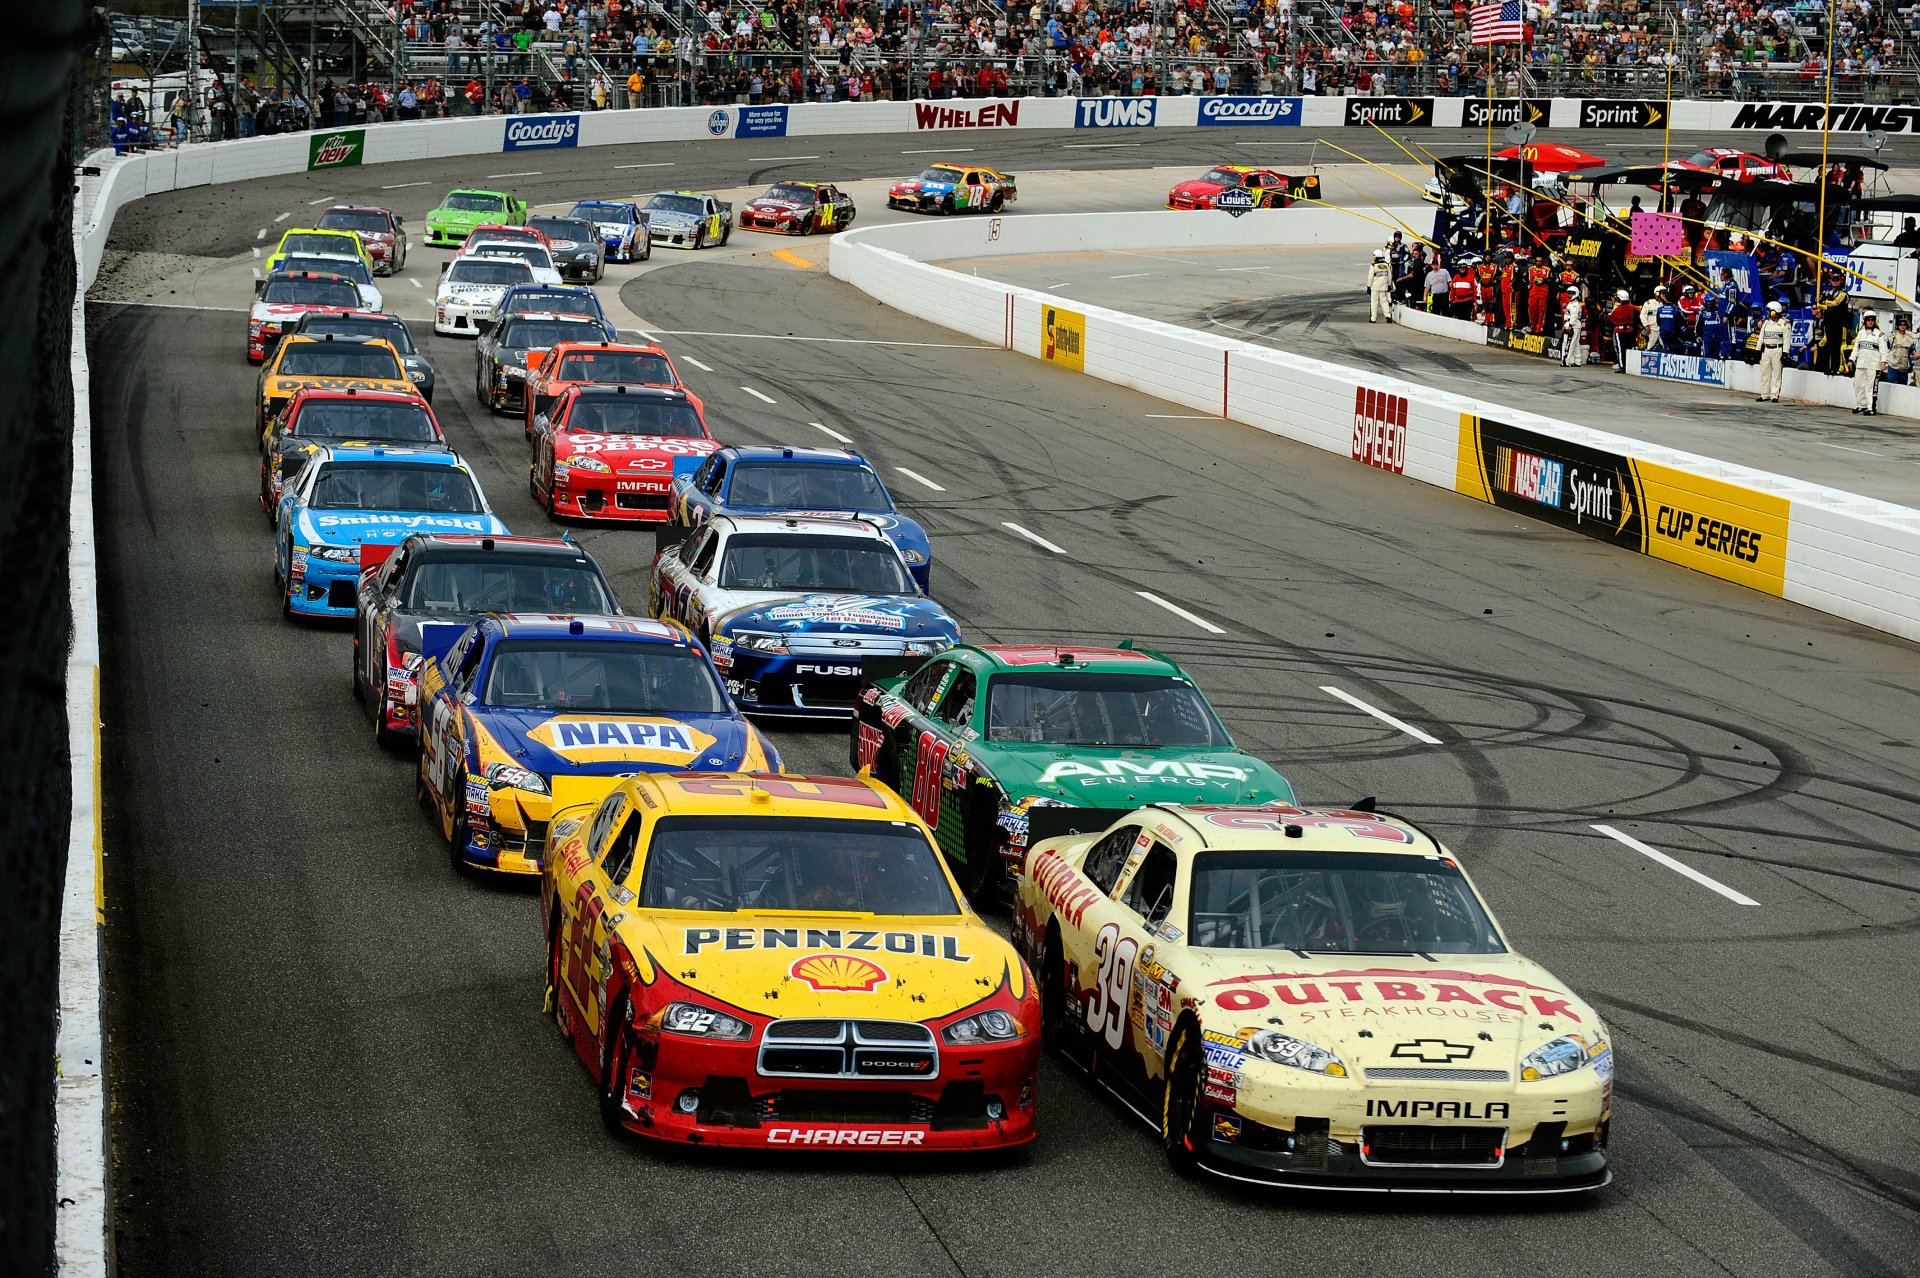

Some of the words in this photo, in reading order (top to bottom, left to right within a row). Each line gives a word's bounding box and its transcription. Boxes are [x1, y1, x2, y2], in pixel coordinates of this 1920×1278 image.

[914, 100, 1020, 129] WHELEN
[1081, 99, 1152, 127] TUMS
[1203, 99, 1293, 121] Goody's
[1351, 102, 1402, 125] Sprint
[1469, 103, 1521, 126] Sprint
[1586, 104, 1639, 127] Sprint
[507, 119, 576, 146] Goody's
[1616, 176, 1627, 184] 15
[967, 185, 984, 208] 18
[1221, 194, 1252, 206] LOWE'S
[820, 203, 834, 227] 24
[710, 213, 721, 239] 48
[988, 218, 1001, 241] 15
[1578, 238, 1602, 258] ENERGY
[1523, 334, 1546, 354] ENERGY
[1659, 353, 1701, 381] FASTENAL
[1353, 413, 1406, 471] SPEED
[1514, 452, 1562, 507] NASCAR
[1569, 468, 1613, 524] Sprint
[318, 514, 484, 531] Smithfield
[1655, 505, 1694, 541] CUP
[1694, 516, 1762, 564] SERIES
[322, 549, 338, 560] 43
[848, 612, 900, 623] Foundation
[874, 619, 902, 628] Good
[712, 633, 734, 645] MOOG
[753, 638, 770, 649] 17
[838, 639, 856, 648] Ford
[711, 644, 733, 656] MAHLE
[388, 667, 411, 680] MAHLE
[558, 722, 690, 751] NAPA
[466, 771, 490, 786] MOOG
[499, 767, 528, 785] 56
[912, 730, 950, 832] 88
[1037, 759, 1247, 783] AMP
[1080, 776, 1231, 789] ENERGY
[465, 786, 489, 802] MAHLE
[466, 802, 484, 813] COMP
[996, 817, 1030, 833] MAHLE
[560, 838, 593, 881] Shell
[1032, 849, 1101, 932] OUTBACK
[684, 927, 973, 963] PENNZOIL
[1086, 922, 1139, 1051] 39
[1215, 981, 1583, 1023] OUTBACK
[676, 1010, 717, 1033] 22
[1301, 1005, 1514, 1025] STEAKHOUSE
[1203, 1030, 1245, 1049] MOOG
[1266, 1038, 1306, 1058] 39
[861, 1060, 921, 1068] DODGE
[1204, 1047, 1246, 1069] MAHLE
[1365, 1098, 1510, 1119] IMPALA
[766, 1127, 925, 1145] CHARGER
